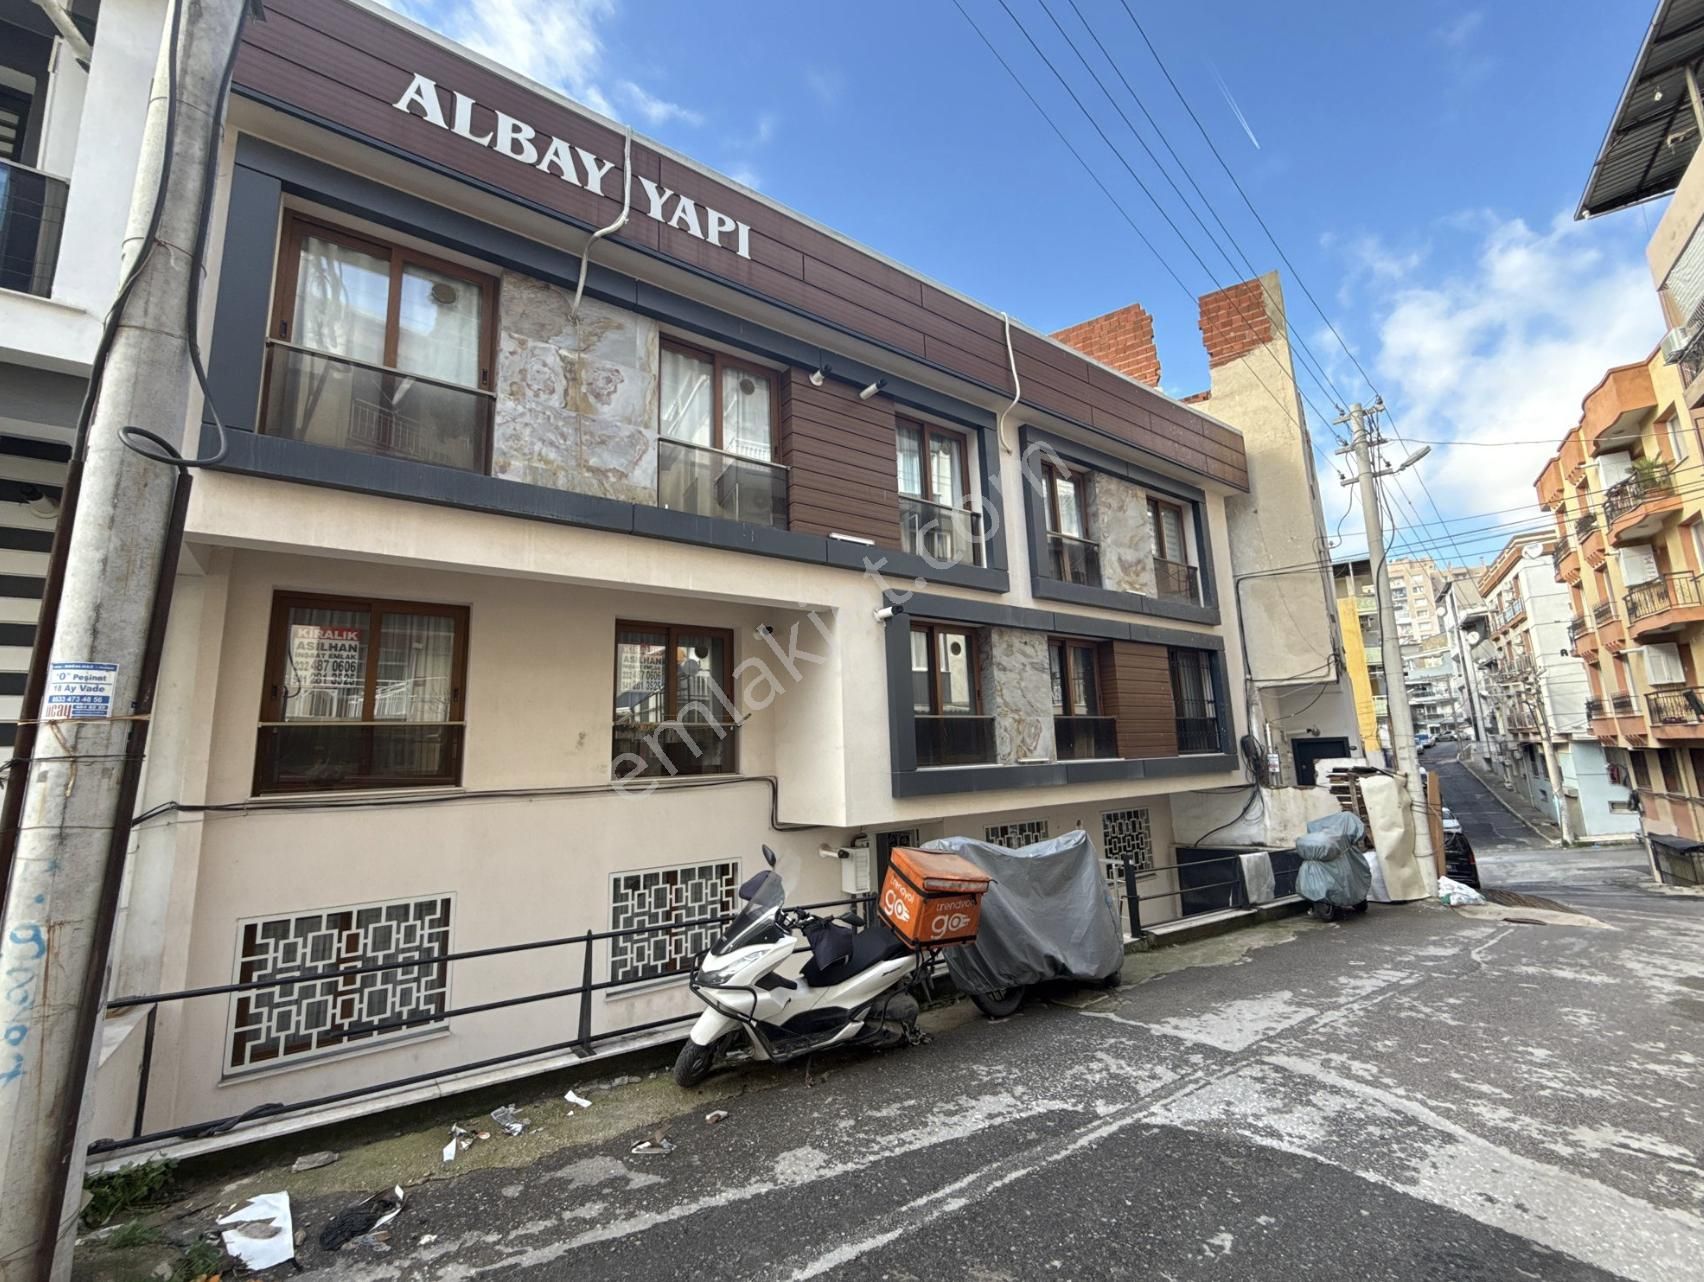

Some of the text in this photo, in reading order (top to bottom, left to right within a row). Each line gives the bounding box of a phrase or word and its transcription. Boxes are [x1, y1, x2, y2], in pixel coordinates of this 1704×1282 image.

[392, 72, 751, 260] ALBAY YAPI
[297, 628, 358, 640] KIRALIK
[332, 660, 357, 673] 0606
[80, 683, 105, 693] Vade
[884, 889, 911, 922] go
[930, 912, 971, 940] go
